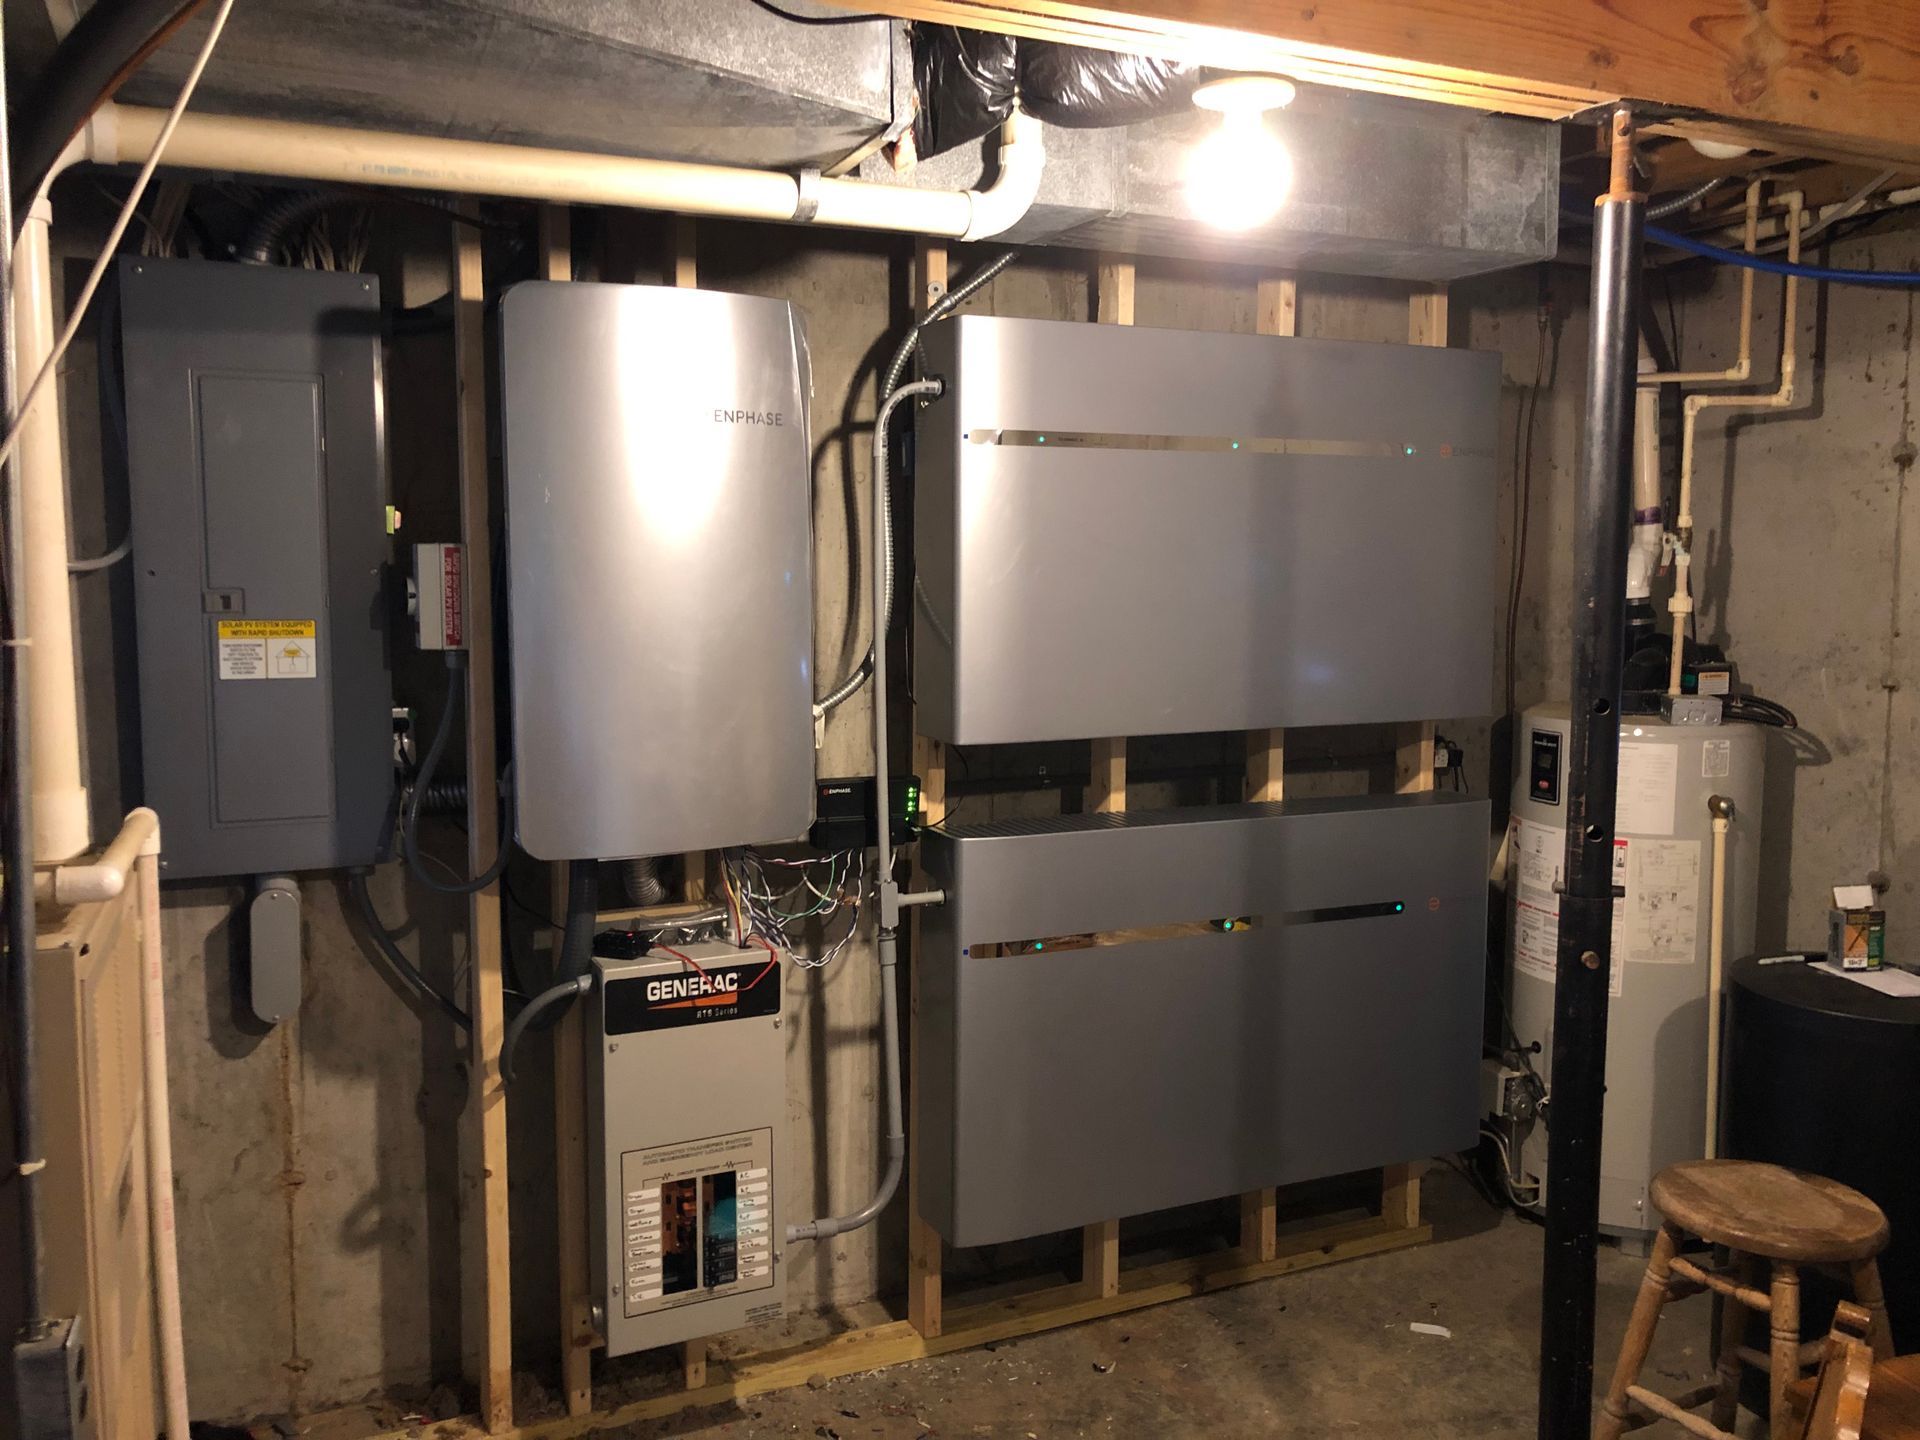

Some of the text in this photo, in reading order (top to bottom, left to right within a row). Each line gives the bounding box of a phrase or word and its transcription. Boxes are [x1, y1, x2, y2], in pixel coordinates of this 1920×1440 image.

[714, 409, 783, 427] ENPHASE
[222, 621, 244, 629] SOLAR
[828, 787, 852, 795] ENPHASE
[646, 972, 739, 1002] GENERAC
